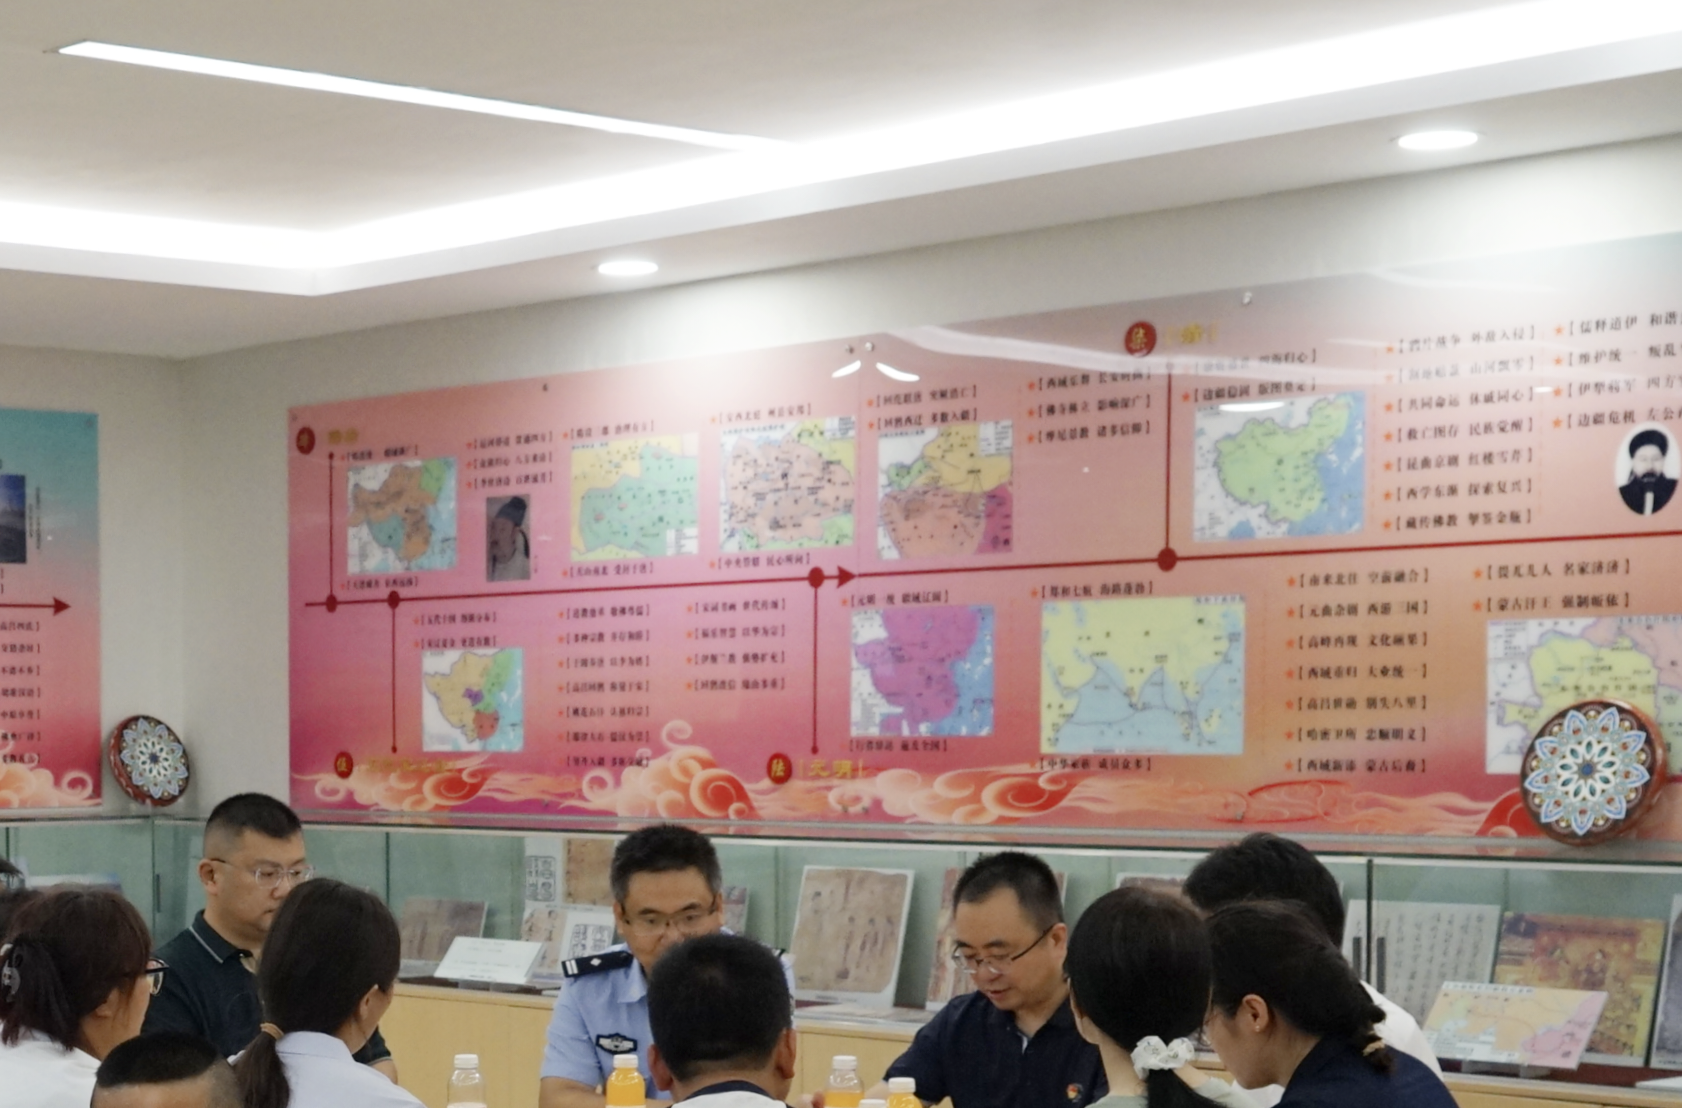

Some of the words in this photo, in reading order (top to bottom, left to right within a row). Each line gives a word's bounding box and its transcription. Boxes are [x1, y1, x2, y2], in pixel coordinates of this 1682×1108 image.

[1650, 311, 1682, 327] 和谐
[1648, 343, 1682, 358] 叛乱
[1647, 374, 1682, 390] 四方
[1397, 395, 1460, 413] 【共同命运
[1469, 386, 1534, 405] 休戚同心】
[1567, 409, 1636, 429] 【边疆危机
[1647, 406, 1682, 421] 左公
[1397, 424, 1459, 443] 【救亡图存
[1469, 416, 1534, 436] 民族觉醒】
[1397, 453, 1459, 472] 【昆曲京剧
[1468, 446, 1533, 466] 红楼雪芹】
[1396, 484, 1459, 501] 【西学东渐
[1468, 478, 1532, 497] 探索复兴】
[1396, 512, 1458, 530] 【藏传佛教
[1562, 559, 1631, 576] 名家济济】
[1300, 603, 1358, 619] 【元曲杂剧
